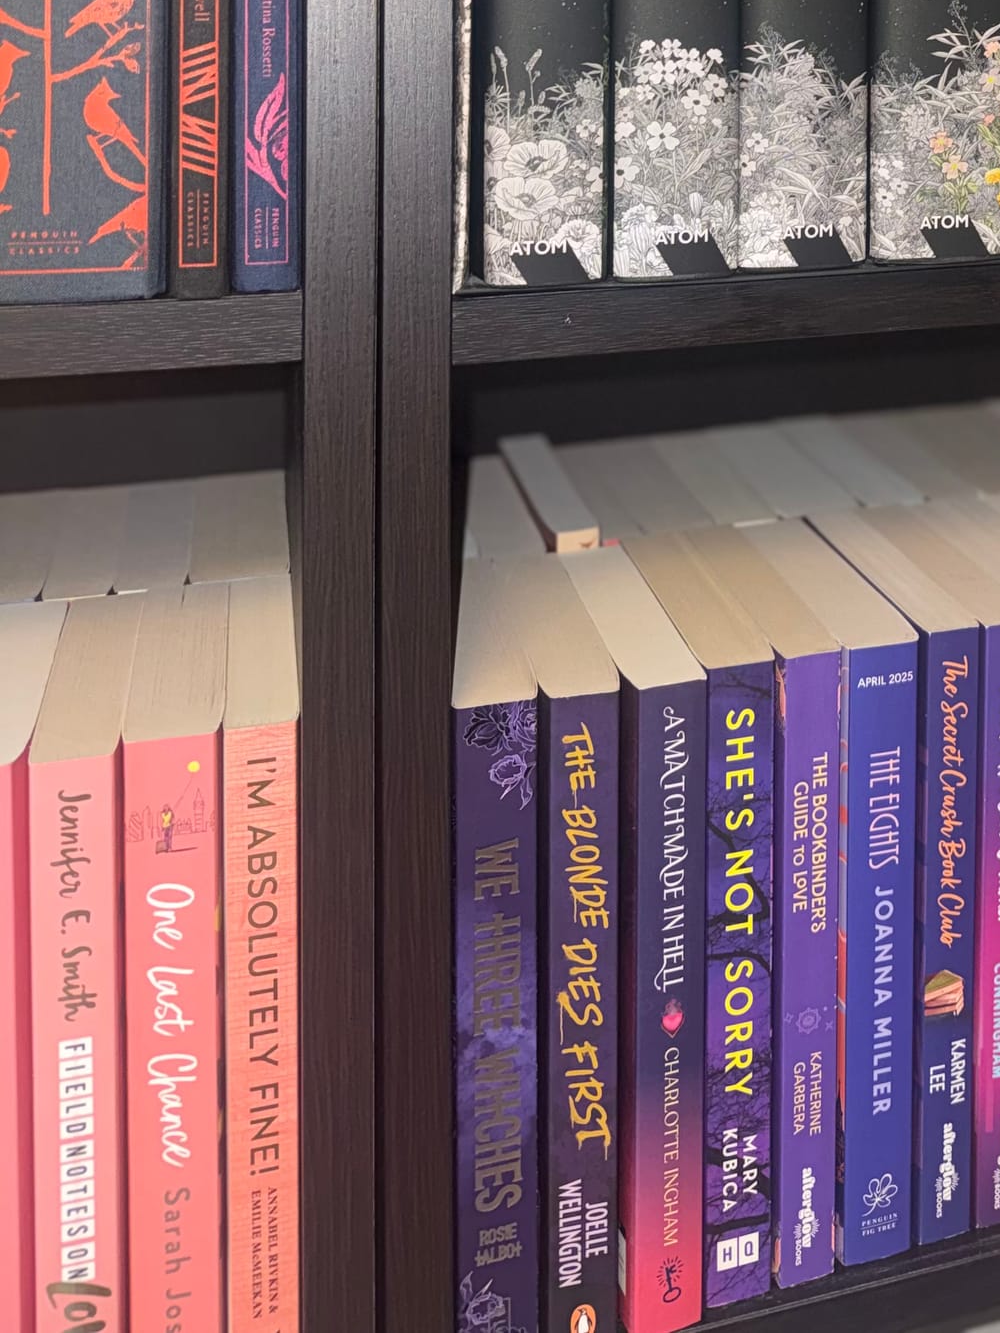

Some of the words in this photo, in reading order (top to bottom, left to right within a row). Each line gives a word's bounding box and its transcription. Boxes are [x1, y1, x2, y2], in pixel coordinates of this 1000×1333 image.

[262, 27, 275, 78] Rossetti
[509, 238, 567, 257] ATOM
[655, 228, 709, 246] ATOM
[783, 222, 833, 241] ATOM
[920, 214, 970, 231] ATOM
[858, 676, 886, 688] APRIL
[889, 671, 913, 684] 2025
[942, 656, 968, 698] The
[660, 707, 687, 733] A
[939, 701, 970, 768] Secret
[247, 756, 277, 808] I'M
[561, 722, 596, 791] THE
[724, 707, 756, 829] SHE'S
[810, 752, 827, 791] THE
[868, 747, 901, 787] THE
[791, 781, 810, 842] GUIDE
[867, 793, 901, 870] EIGHTS
[938, 769, 966, 838] Crush
[50, 790, 91, 898] Jennifer
[561, 806, 609, 928] BLONDE
[809, 795, 828, 933] BOOKBINDER'S
[938, 840, 966, 890] Book
[60, 911, 89, 934] E.
[146, 883, 195, 950] One
[662, 905, 684, 931] IN
[724, 849, 755, 935] NOT
[938, 893, 963, 948] Club
[247, 826, 279, 1067] ABSOLUTELY
[654, 935, 684, 992] HELL
[873, 885, 895, 1007] JOANNA
[57, 946, 97, 1022] Smith
[146, 966, 194, 1037] Last
[556, 938, 604, 1027] DIES
[724, 959, 754, 1096] SORRY
[61, 1040, 91, 1136] FIELD
[871, 1017, 892, 1115] MILLER
[147, 1053, 198, 1167] Chance
[249, 1083, 279, 1176] FINE!
[560, 1042, 612, 1160] FIRST
[662, 1046, 680, 1163] CHARLOTTE
[62, 1143, 91, 1238] NOTES
[721, 1128, 737, 1212] KUBICA
[742, 1135, 758, 1195] MARY
[251, 1190, 262, 1239] EMILIE
[267, 1187, 281, 1250] ANNABEL
[557, 1179, 582, 1288] WELLINGTON
[584, 1202, 608, 1258] JOELLE
[661, 1168, 681, 1246] INGHAM
[63, 1246, 92, 1279] ON
[268, 1252, 280, 1301] RIVKIN
[268, 1304, 277, 1313] &
